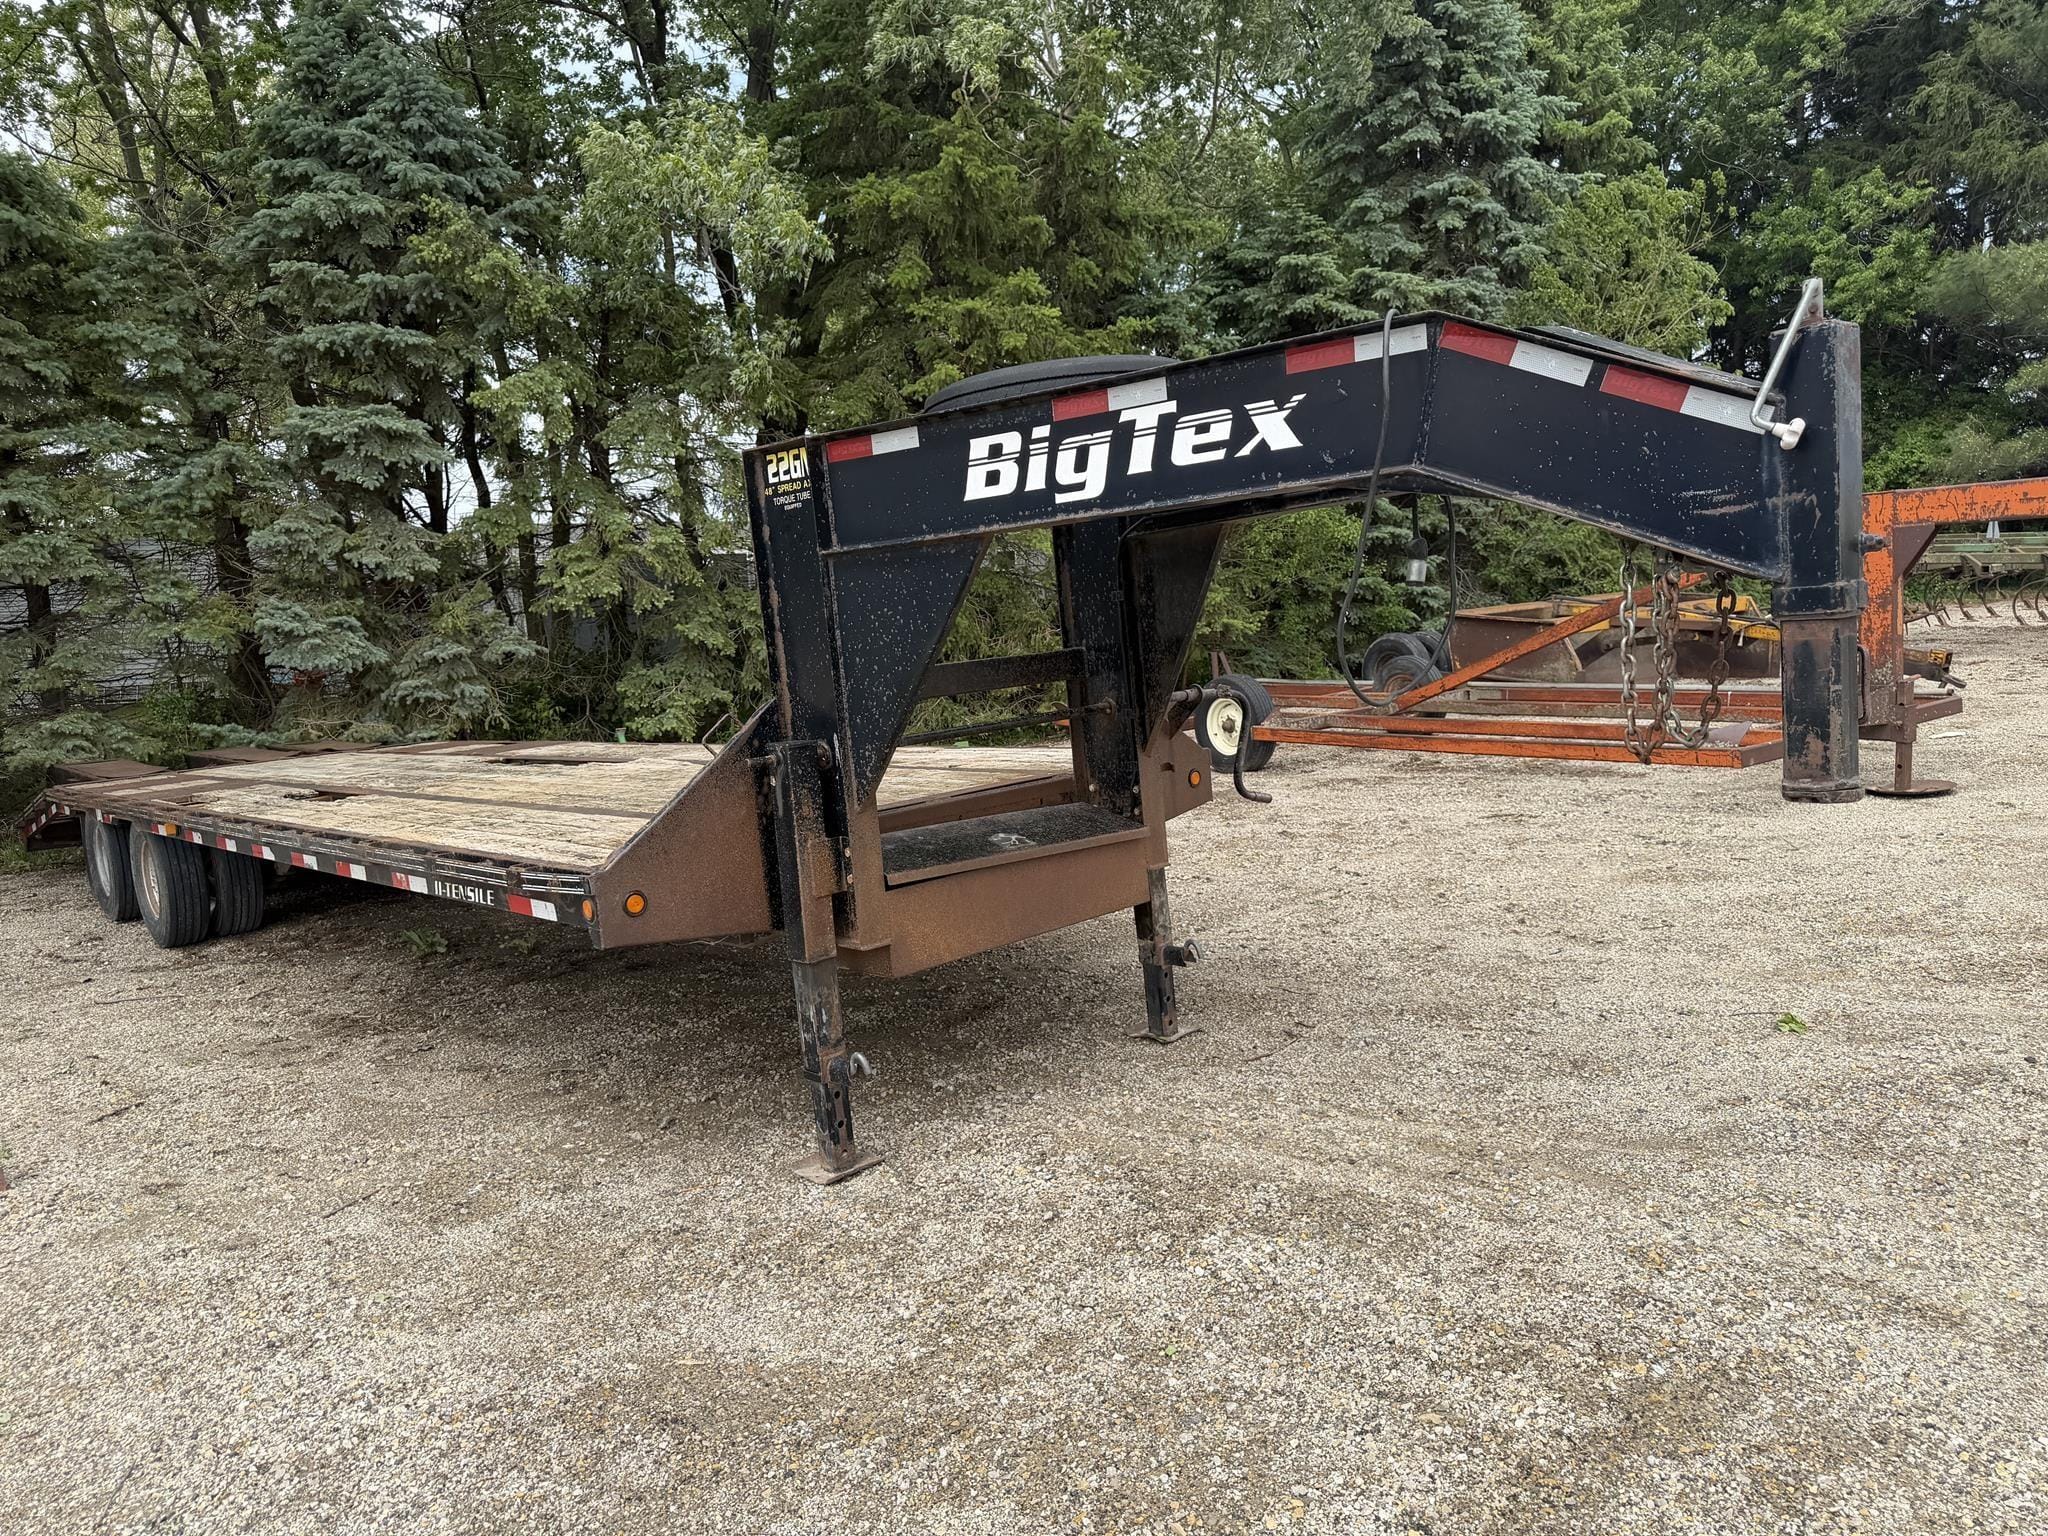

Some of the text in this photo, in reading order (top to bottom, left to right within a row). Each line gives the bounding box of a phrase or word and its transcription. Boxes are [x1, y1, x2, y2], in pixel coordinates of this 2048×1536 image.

[963, 393, 1307, 504] BigTex
[777, 482, 802, 494] SPREAD
[773, 490, 812, 506] TORQUE TUBE
